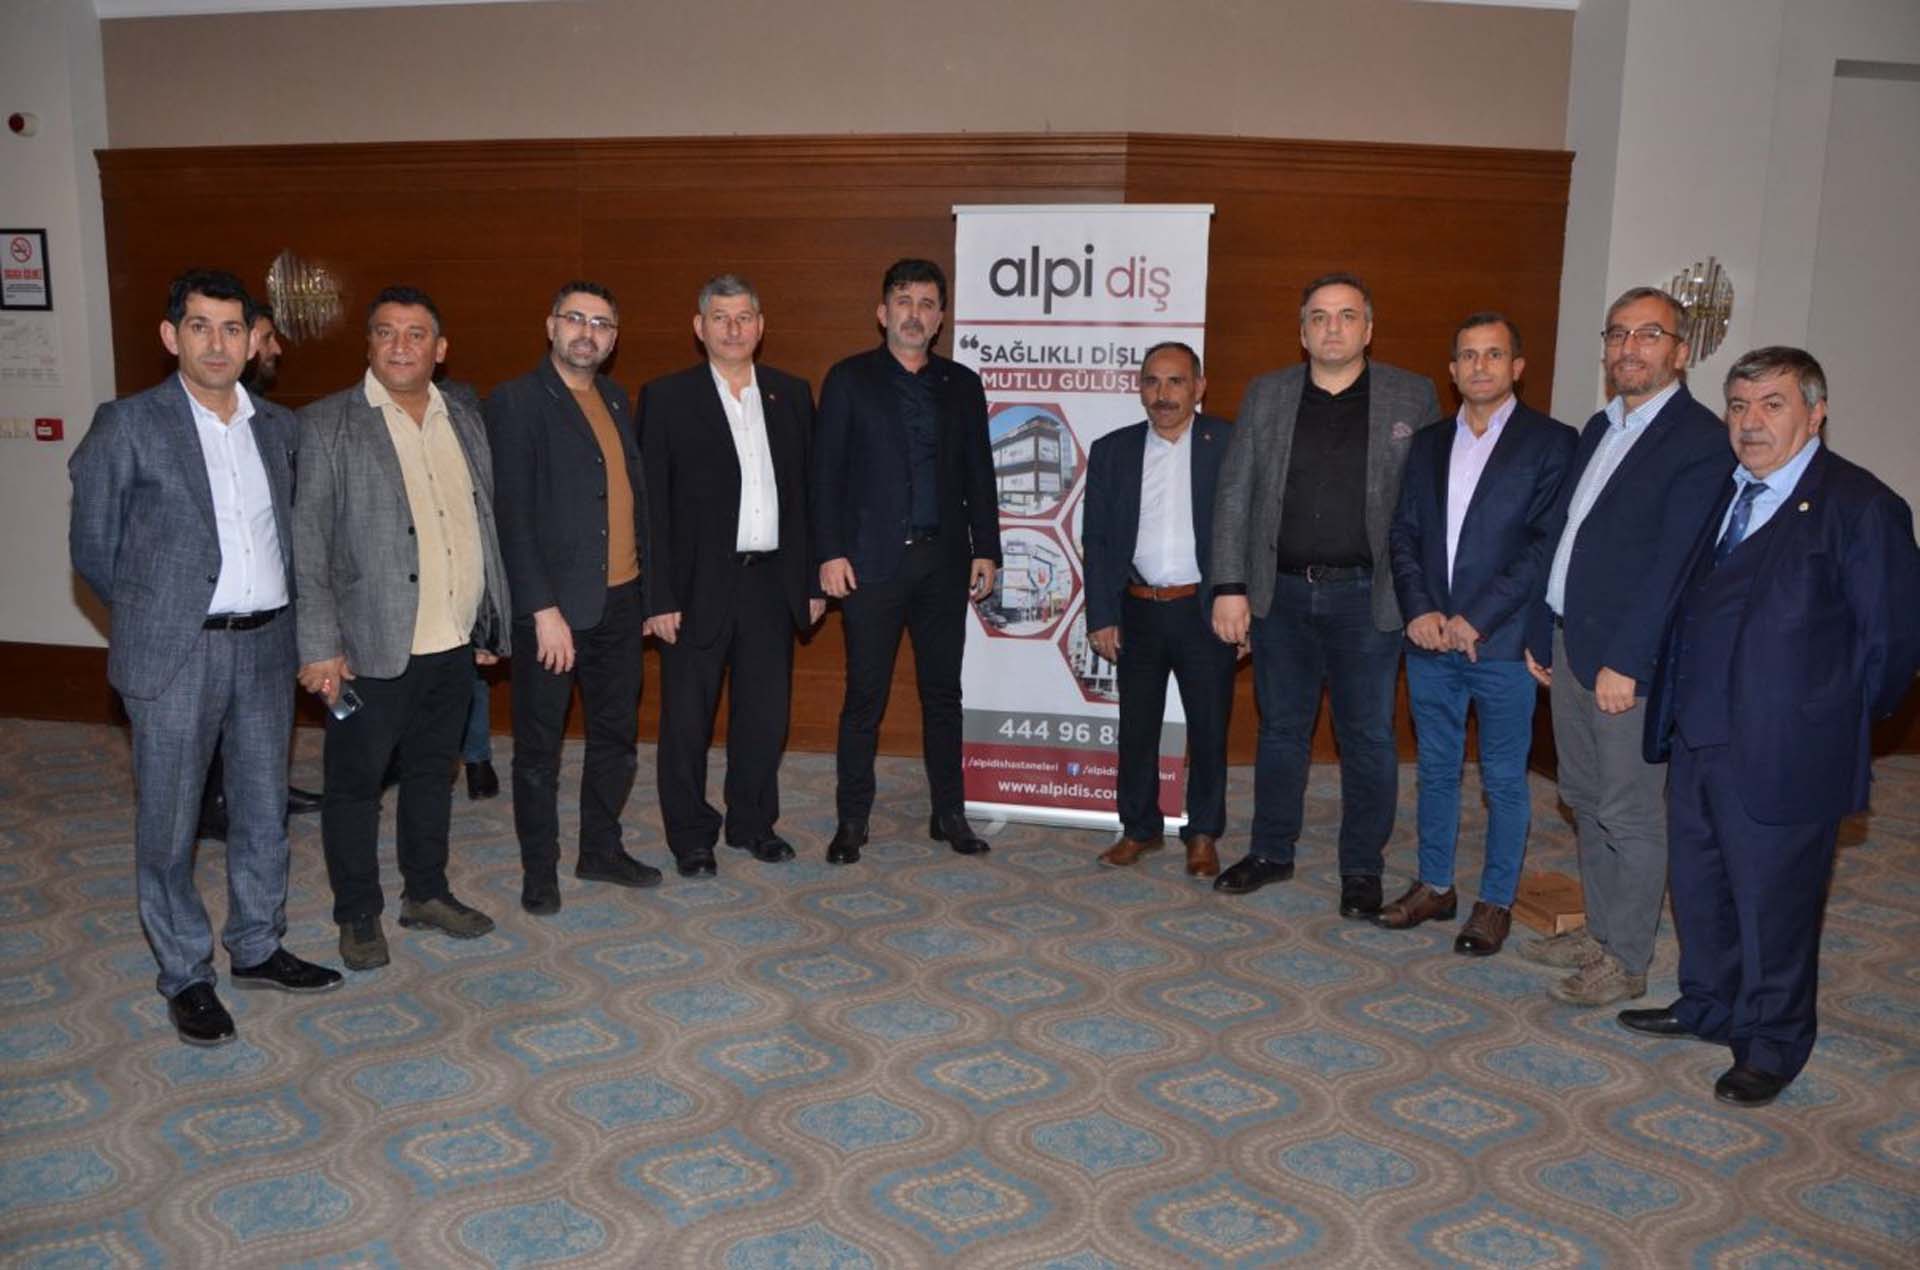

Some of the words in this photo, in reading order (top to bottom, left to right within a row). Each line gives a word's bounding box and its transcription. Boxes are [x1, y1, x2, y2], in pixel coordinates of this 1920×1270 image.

[989, 244, 1094, 314] alpi
[1105, 256, 1171, 312] diş
[1091, 343, 1149, 367] DİŞL
[982, 373, 1051, 390] MUTLU
[1059, 370, 1141, 393] GÜLÜŞL
[999, 718, 1050, 740] 444
[1058, 722, 1090, 742] 96
[1099, 725, 1118, 745] 8
